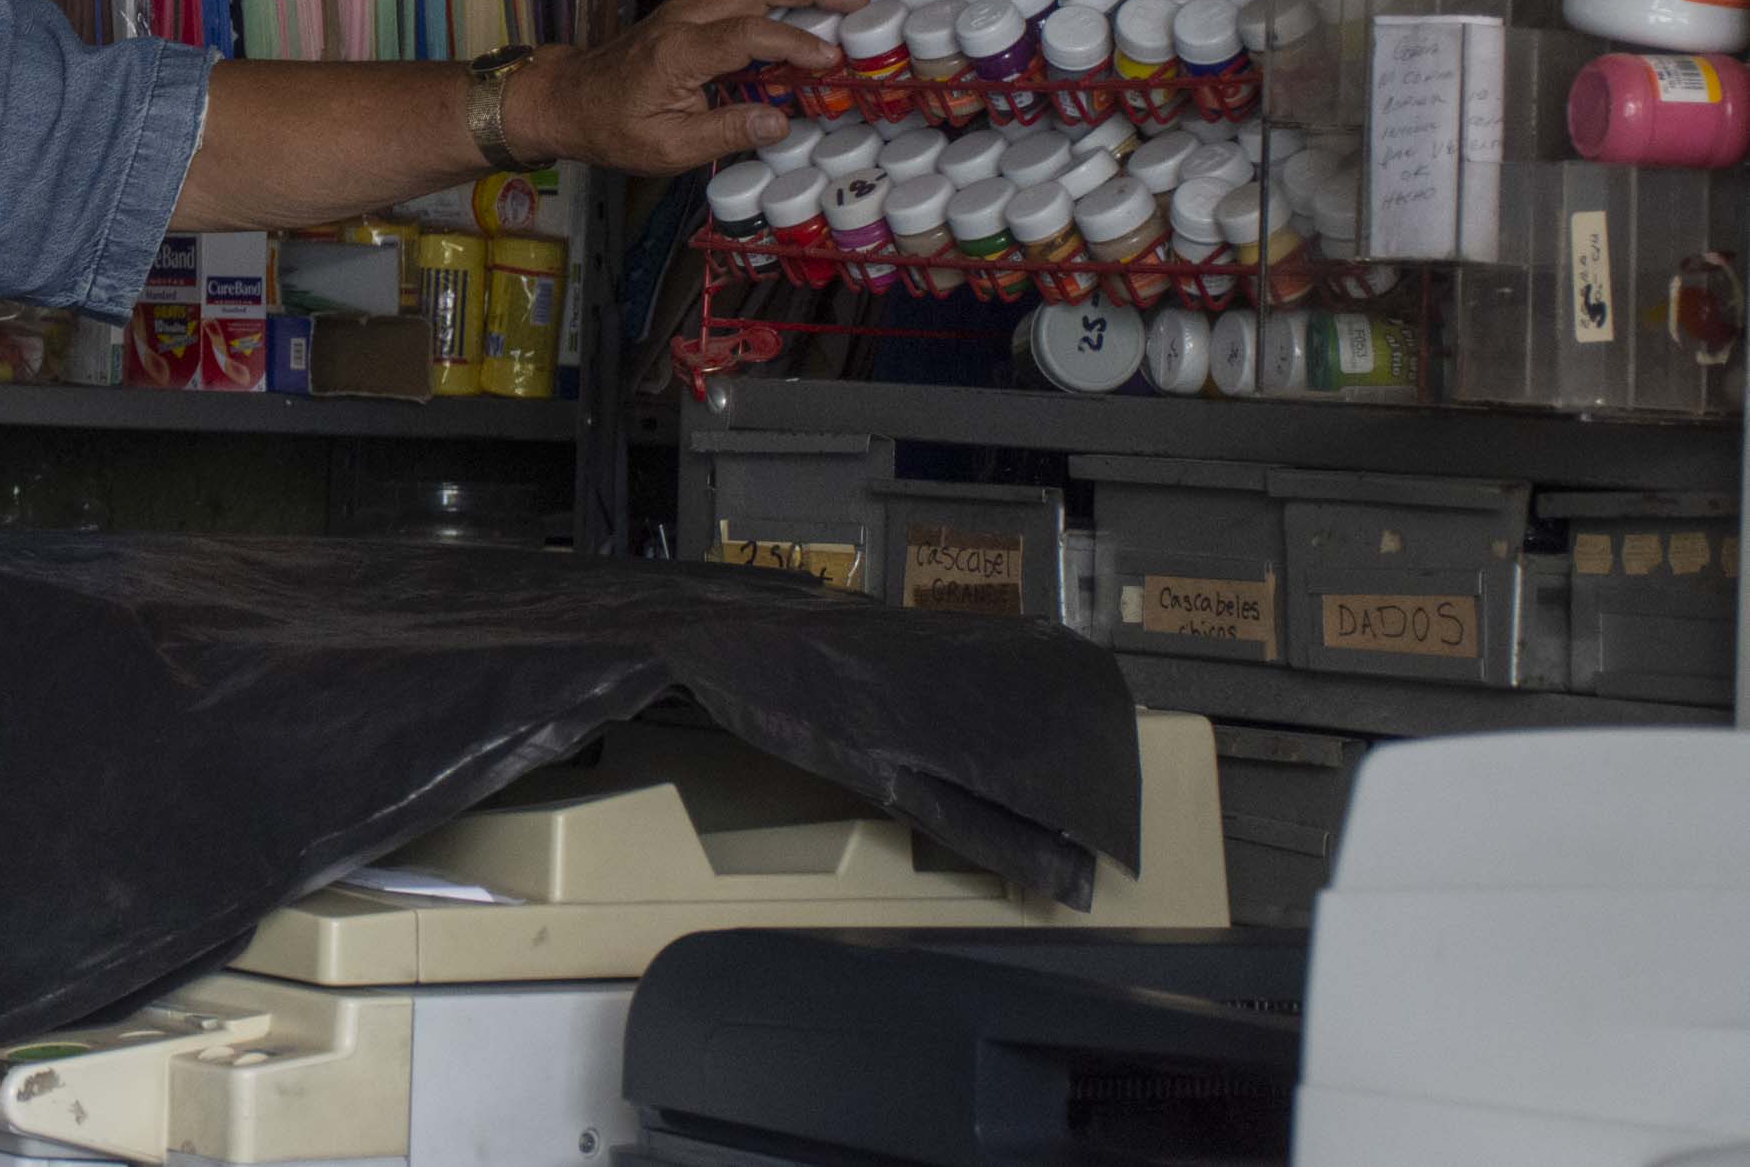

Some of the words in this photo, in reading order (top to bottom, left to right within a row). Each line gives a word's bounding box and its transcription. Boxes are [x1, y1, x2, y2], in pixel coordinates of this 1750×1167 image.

[206, 279, 263, 299] CureBand
[1159, 586, 1262, 622] Cascabeles
[1337, 601, 1466, 647] DADOS
